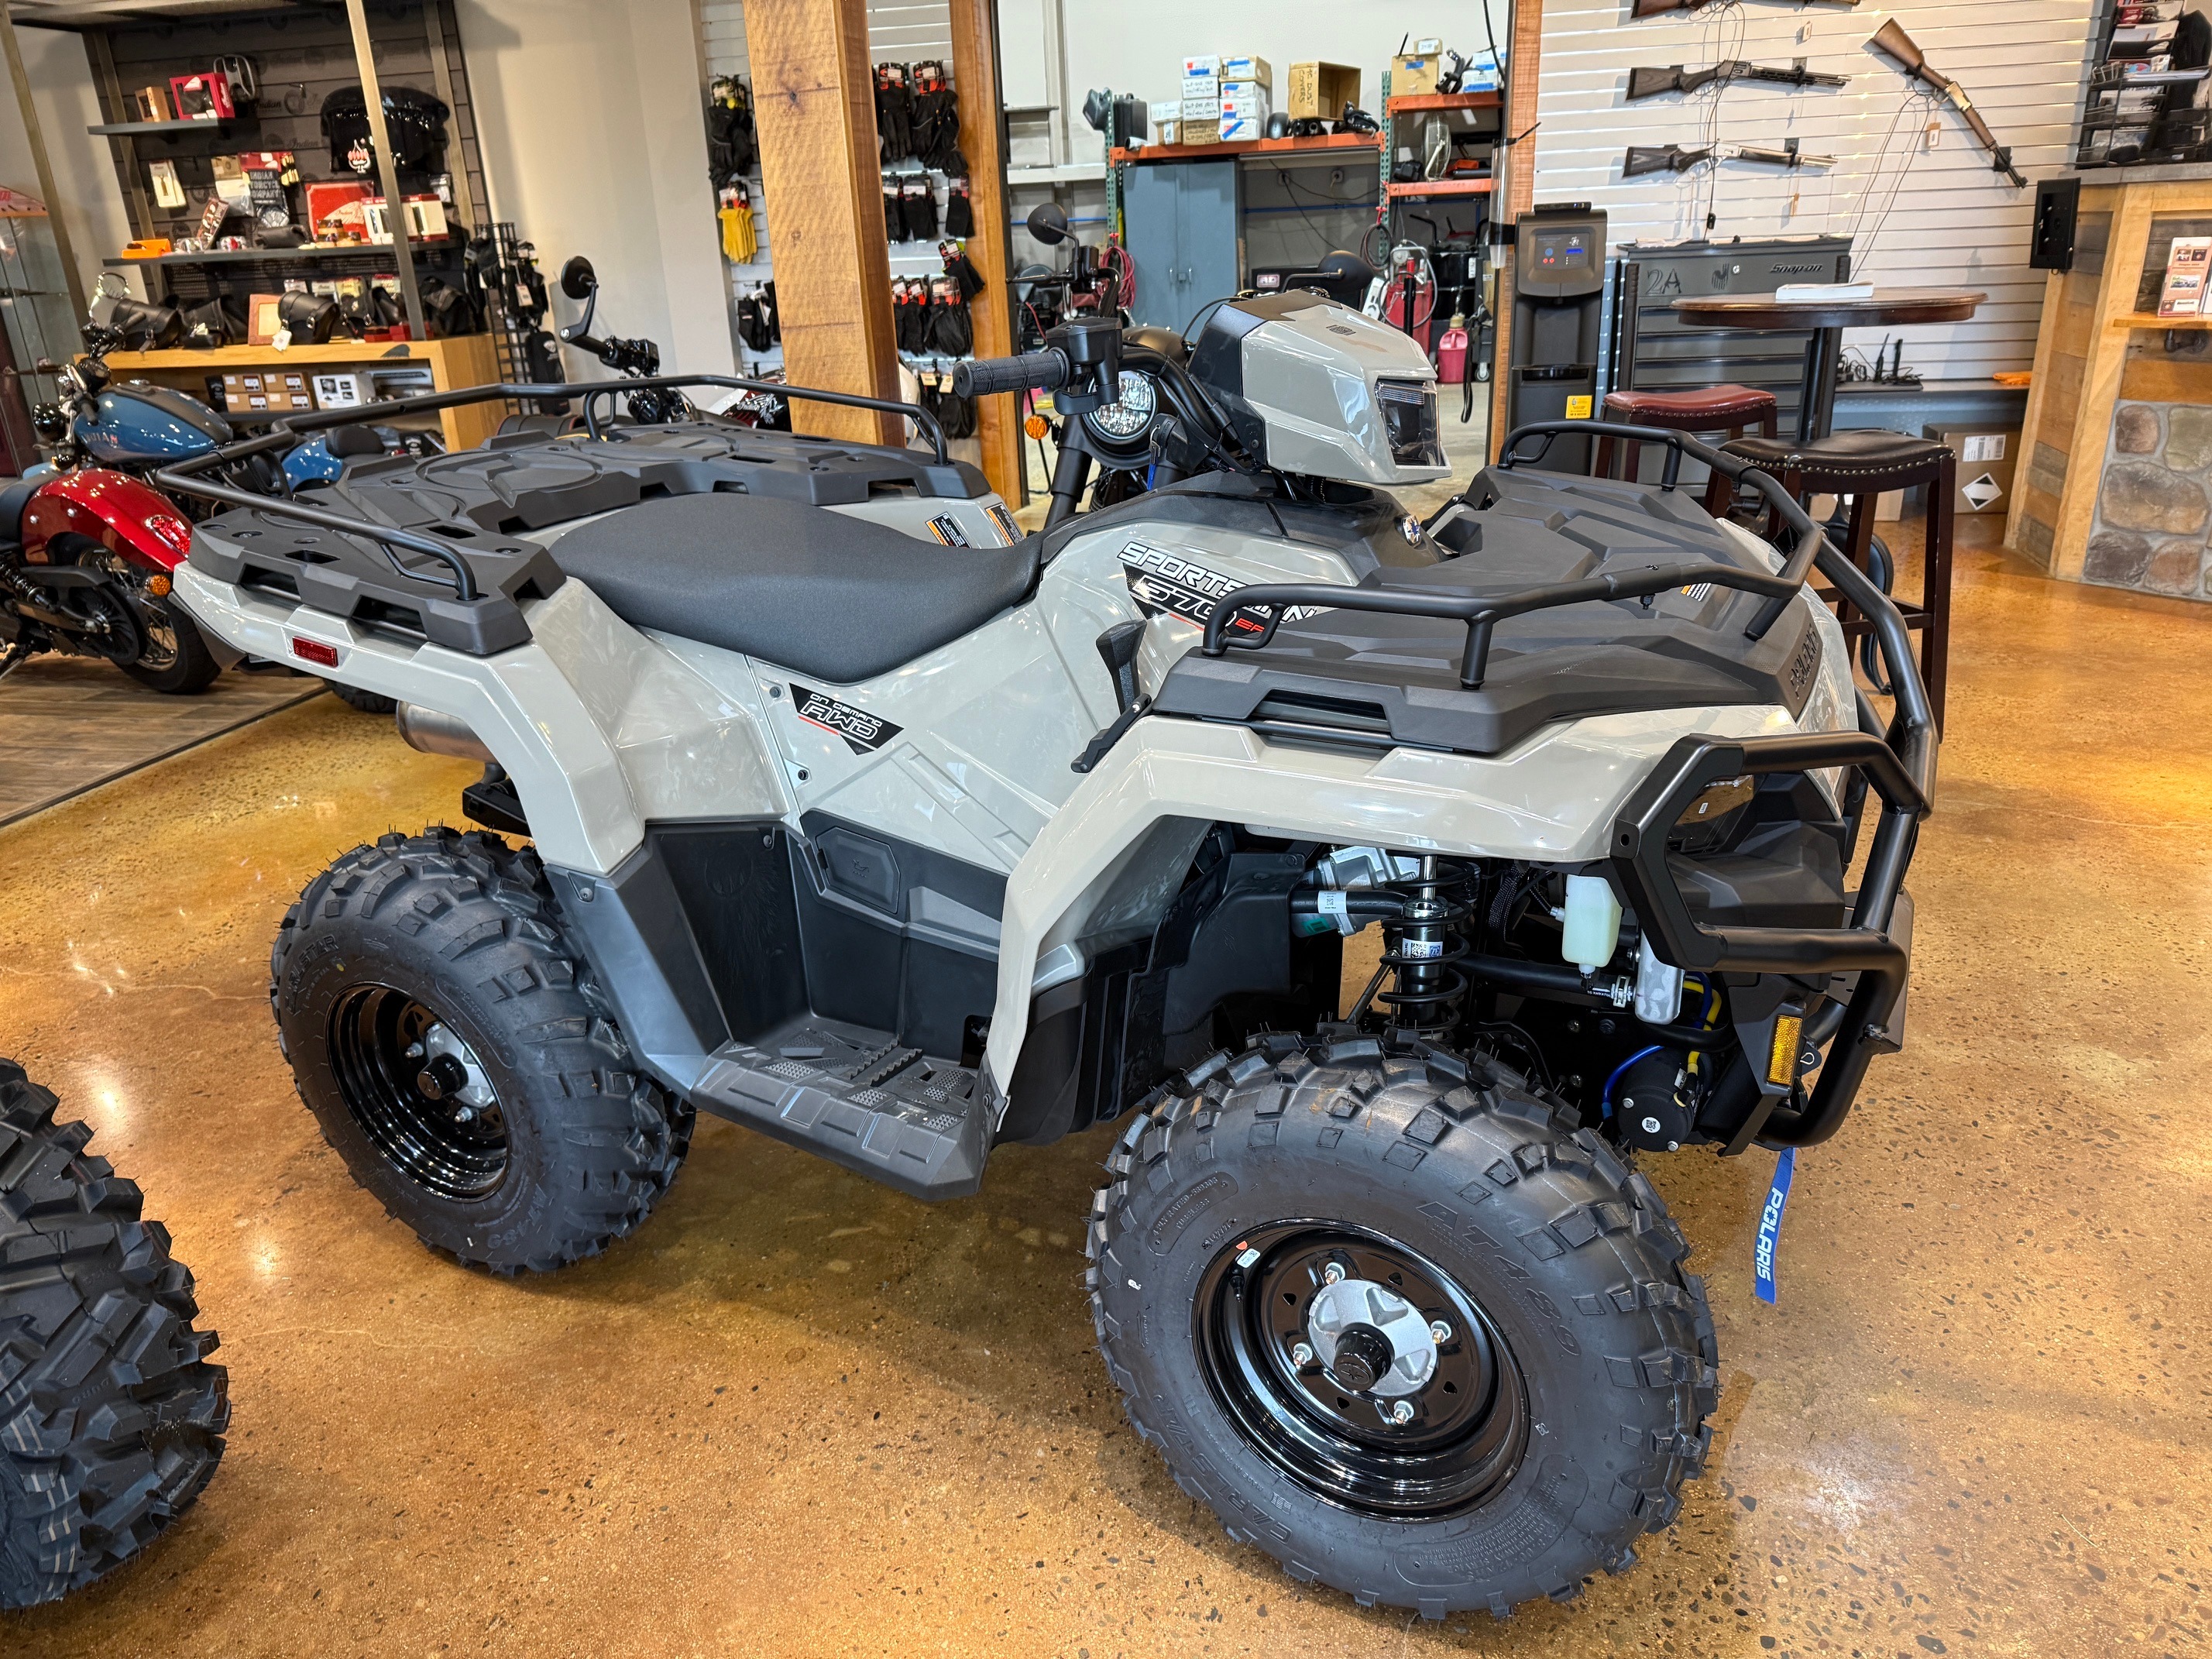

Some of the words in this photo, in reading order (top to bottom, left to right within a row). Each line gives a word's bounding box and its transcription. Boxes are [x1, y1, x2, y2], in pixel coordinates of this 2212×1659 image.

[1298, 69, 1307, 104] COVERS
[249, 171, 273, 180] INDIAN
[1646, 268, 1682, 295] 2A
[1770, 263, 1823, 275] Snap-on
[799, 700, 879, 740] AWD
[810, 693, 829, 706] ON
[833, 702, 884, 728] DEMAND
[1168, 1194, 1190, 1218] RATED
[1174, 1197, 1211, 1230] TUBELESS
[1757, 1187, 1784, 1282] POLARIS
[1152, 1393, 1293, 1544] CARLSTAR
[1233, 1462, 1242, 1474] IN
[1242, 1472, 1265, 1492] MADE
[1494, 1535, 1534, 1562] HIGHWAY
